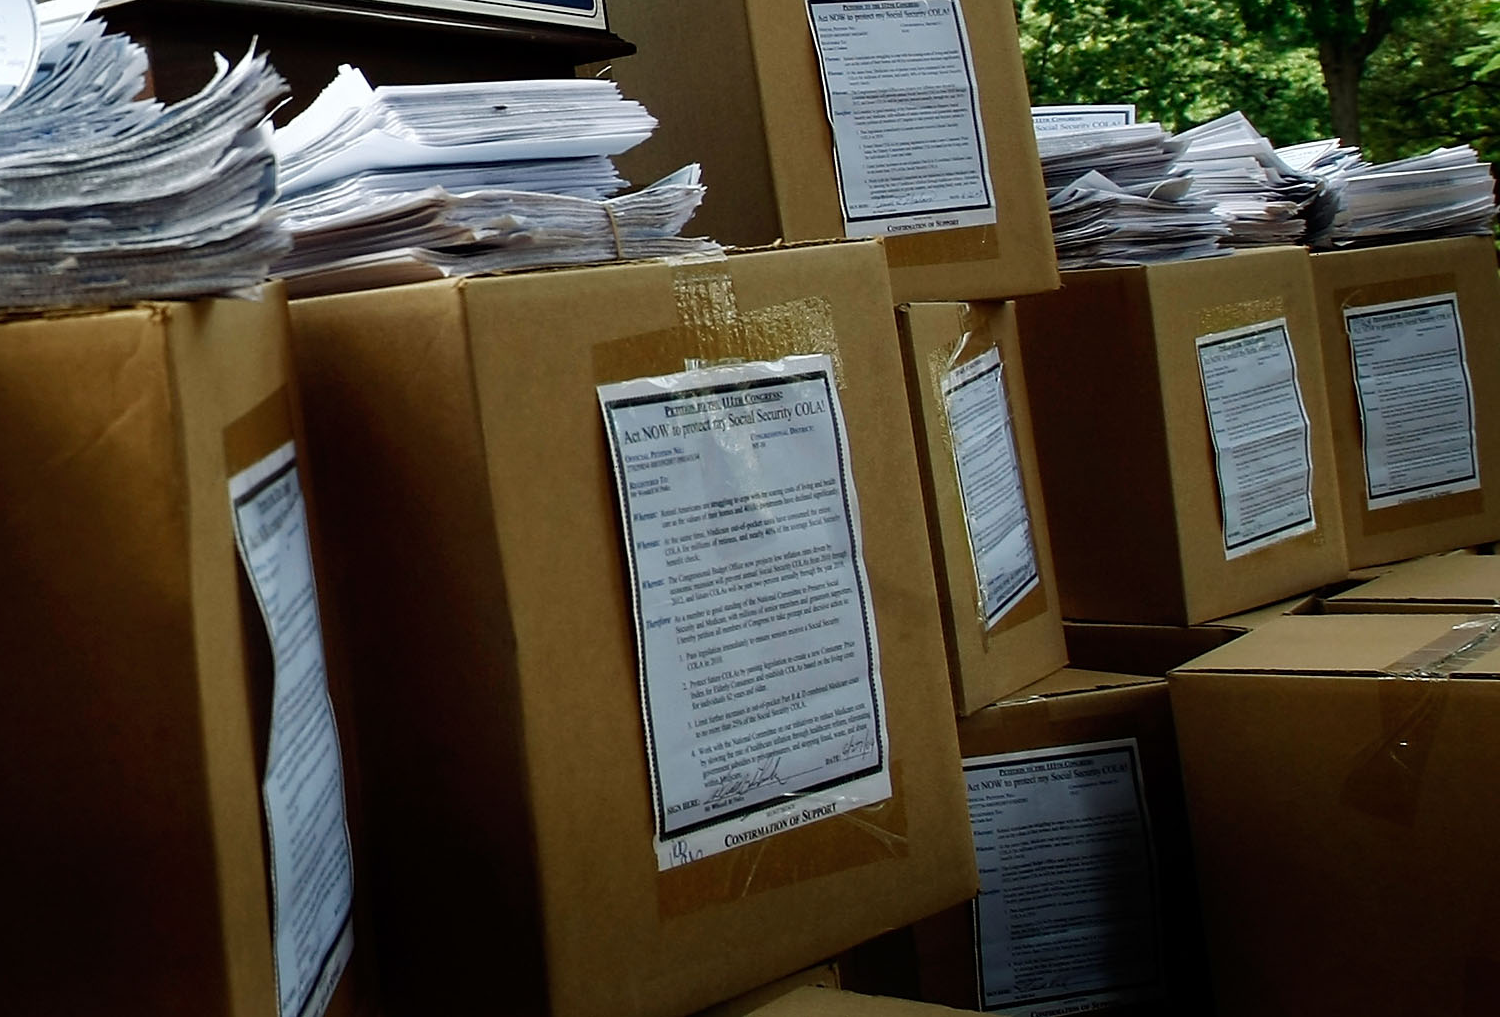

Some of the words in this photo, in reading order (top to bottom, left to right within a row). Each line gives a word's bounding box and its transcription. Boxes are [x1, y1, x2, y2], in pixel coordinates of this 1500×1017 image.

[624, 429, 641, 444] Act
[642, 424, 670, 441] NOW
[672, 425, 681, 436] to
[682, 420, 711, 438] protect
[728, 410, 755, 427] Social
[755, 404, 794, 426] Security
[794, 399, 825, 416] COLA!
[980, 779, 1003, 790] NOW
[723, 815, 787, 849] CONFIRMATION
[788, 811, 800, 827] OF
[801, 799, 837, 823] SUPPORT
